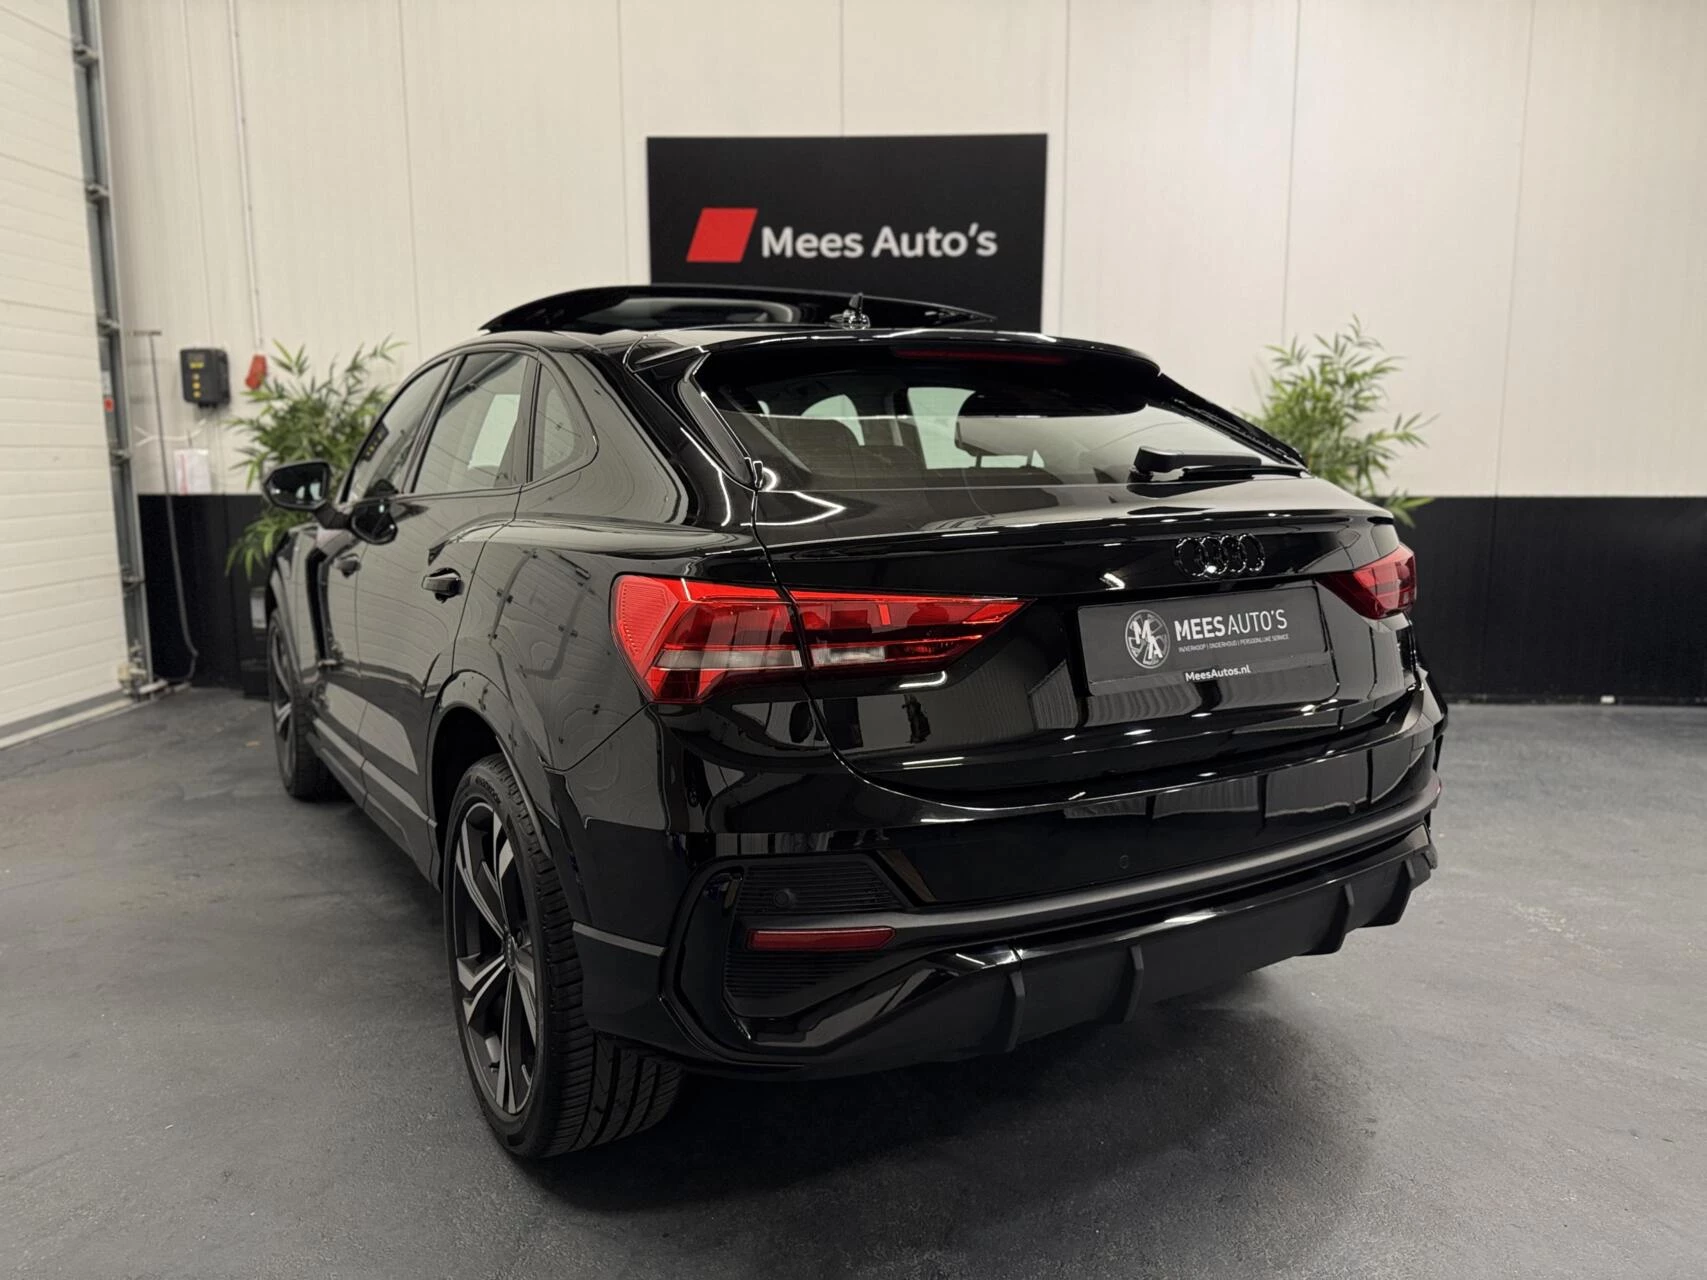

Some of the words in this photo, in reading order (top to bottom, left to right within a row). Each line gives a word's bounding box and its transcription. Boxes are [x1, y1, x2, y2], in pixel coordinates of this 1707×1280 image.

[761, 226, 864, 258] Mees
[871, 222, 998, 258] Auto's
[1185, 664, 1251, 682] MeesAutos.nl
